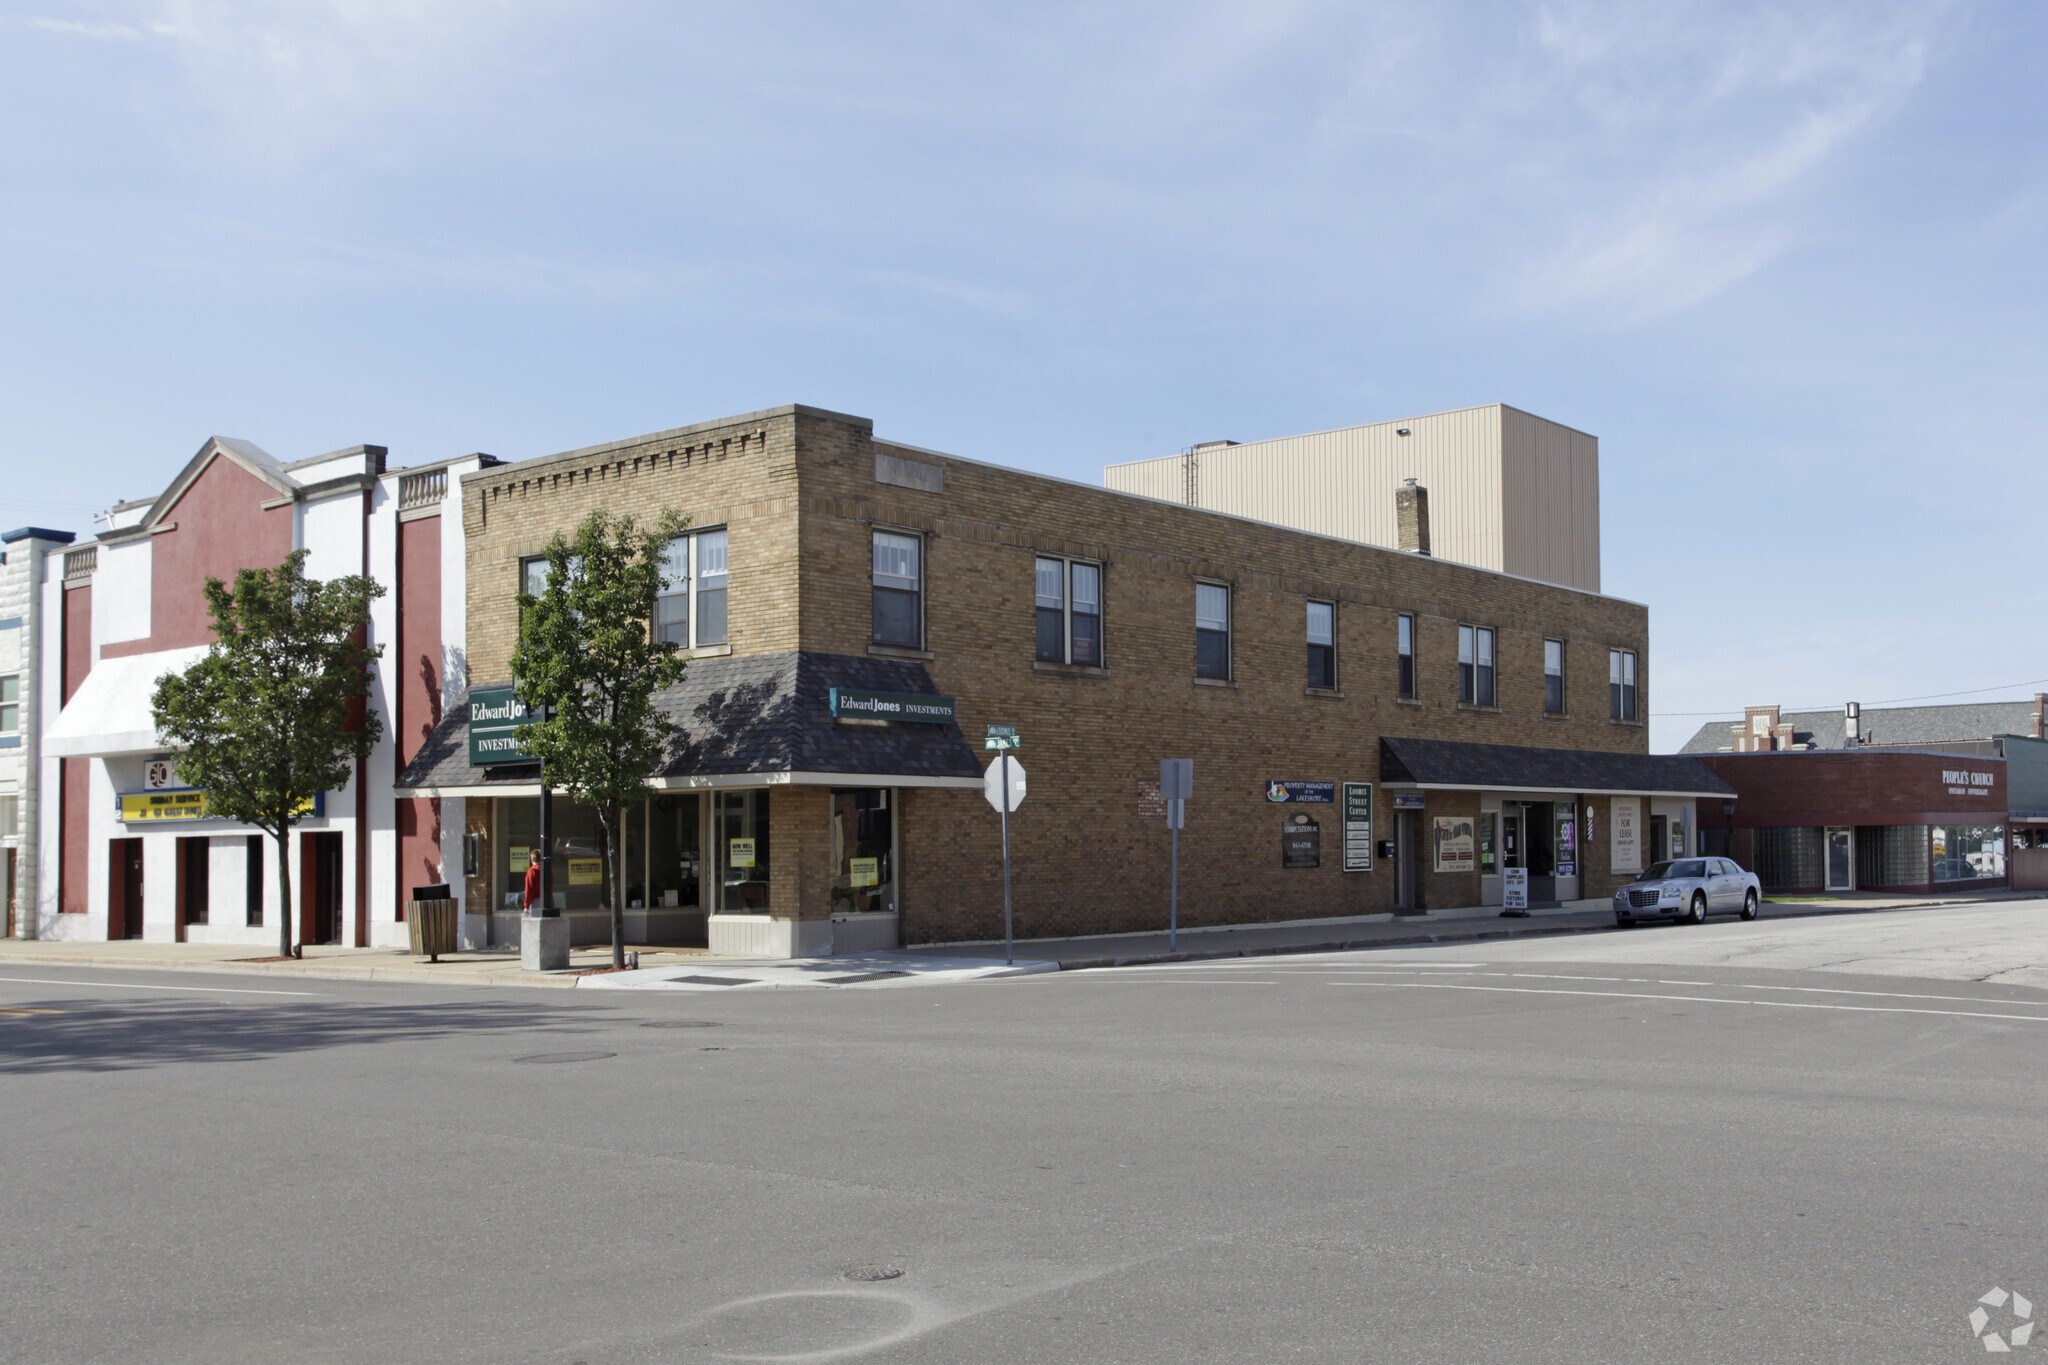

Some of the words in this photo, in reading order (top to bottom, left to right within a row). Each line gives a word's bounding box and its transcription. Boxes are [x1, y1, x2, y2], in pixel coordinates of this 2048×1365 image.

[471, 700, 526, 721] EdwardJo
[840, 696, 901, 712] EdwardJones
[905, 704, 952, 716] INVESTMENTS
[1942, 770, 1969, 784] PEOPLE'S
[1971, 772, 1993, 785] CHURCH
[175, 793, 201, 803] SERVICE
[1348, 796, 1367, 806] STREET
[1349, 806, 1368, 816] CENTER
[1620, 818, 1631, 828] FOR
[1619, 829, 1633, 839] LEASE
